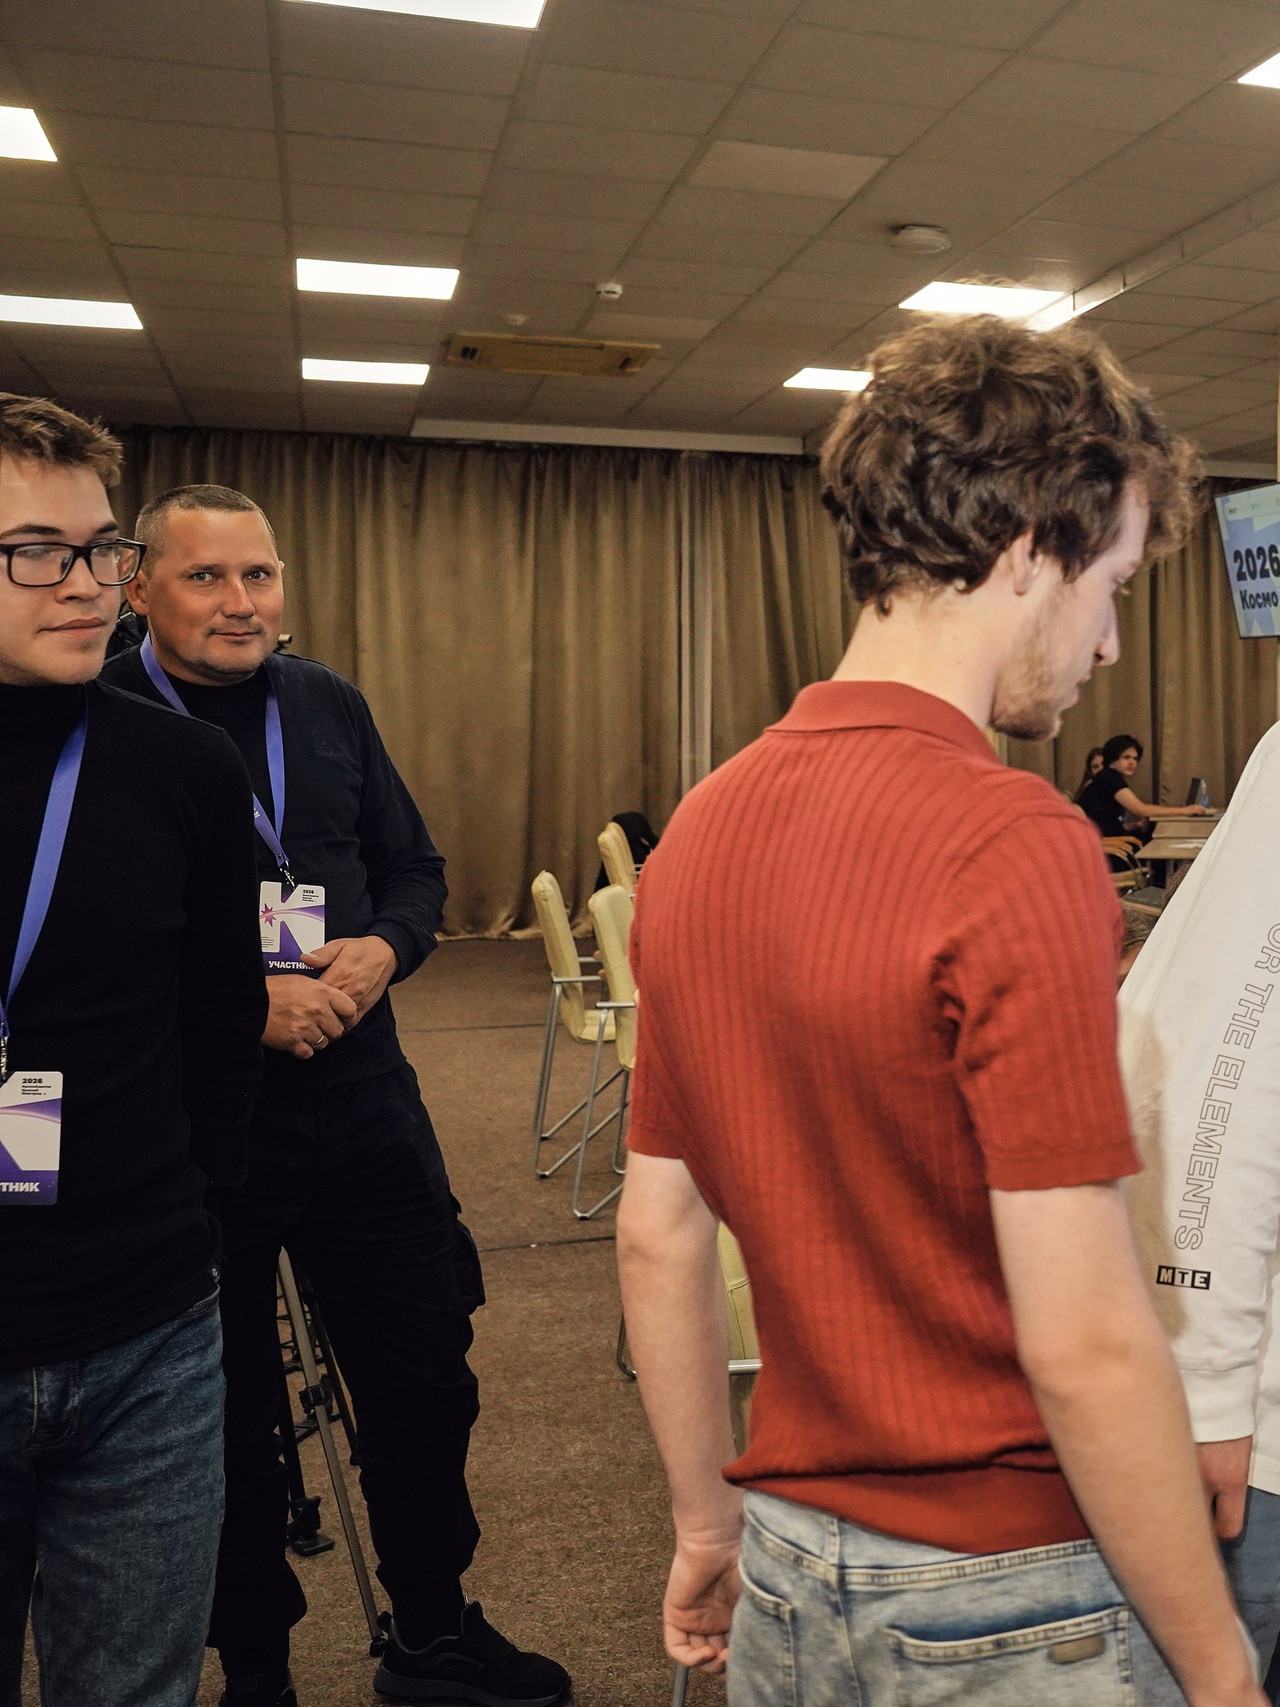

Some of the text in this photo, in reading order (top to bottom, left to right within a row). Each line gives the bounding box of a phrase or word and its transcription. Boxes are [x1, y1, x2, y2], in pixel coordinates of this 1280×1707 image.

[1239, 589, 1279, 611] Космо
[1222, 983, 1274, 1050] THE
[1174, 1054, 1245, 1251] ELEMENTS
[0, 1181, 40, 1193] ТНИК
[1157, 1265, 1211, 1290] MTE
